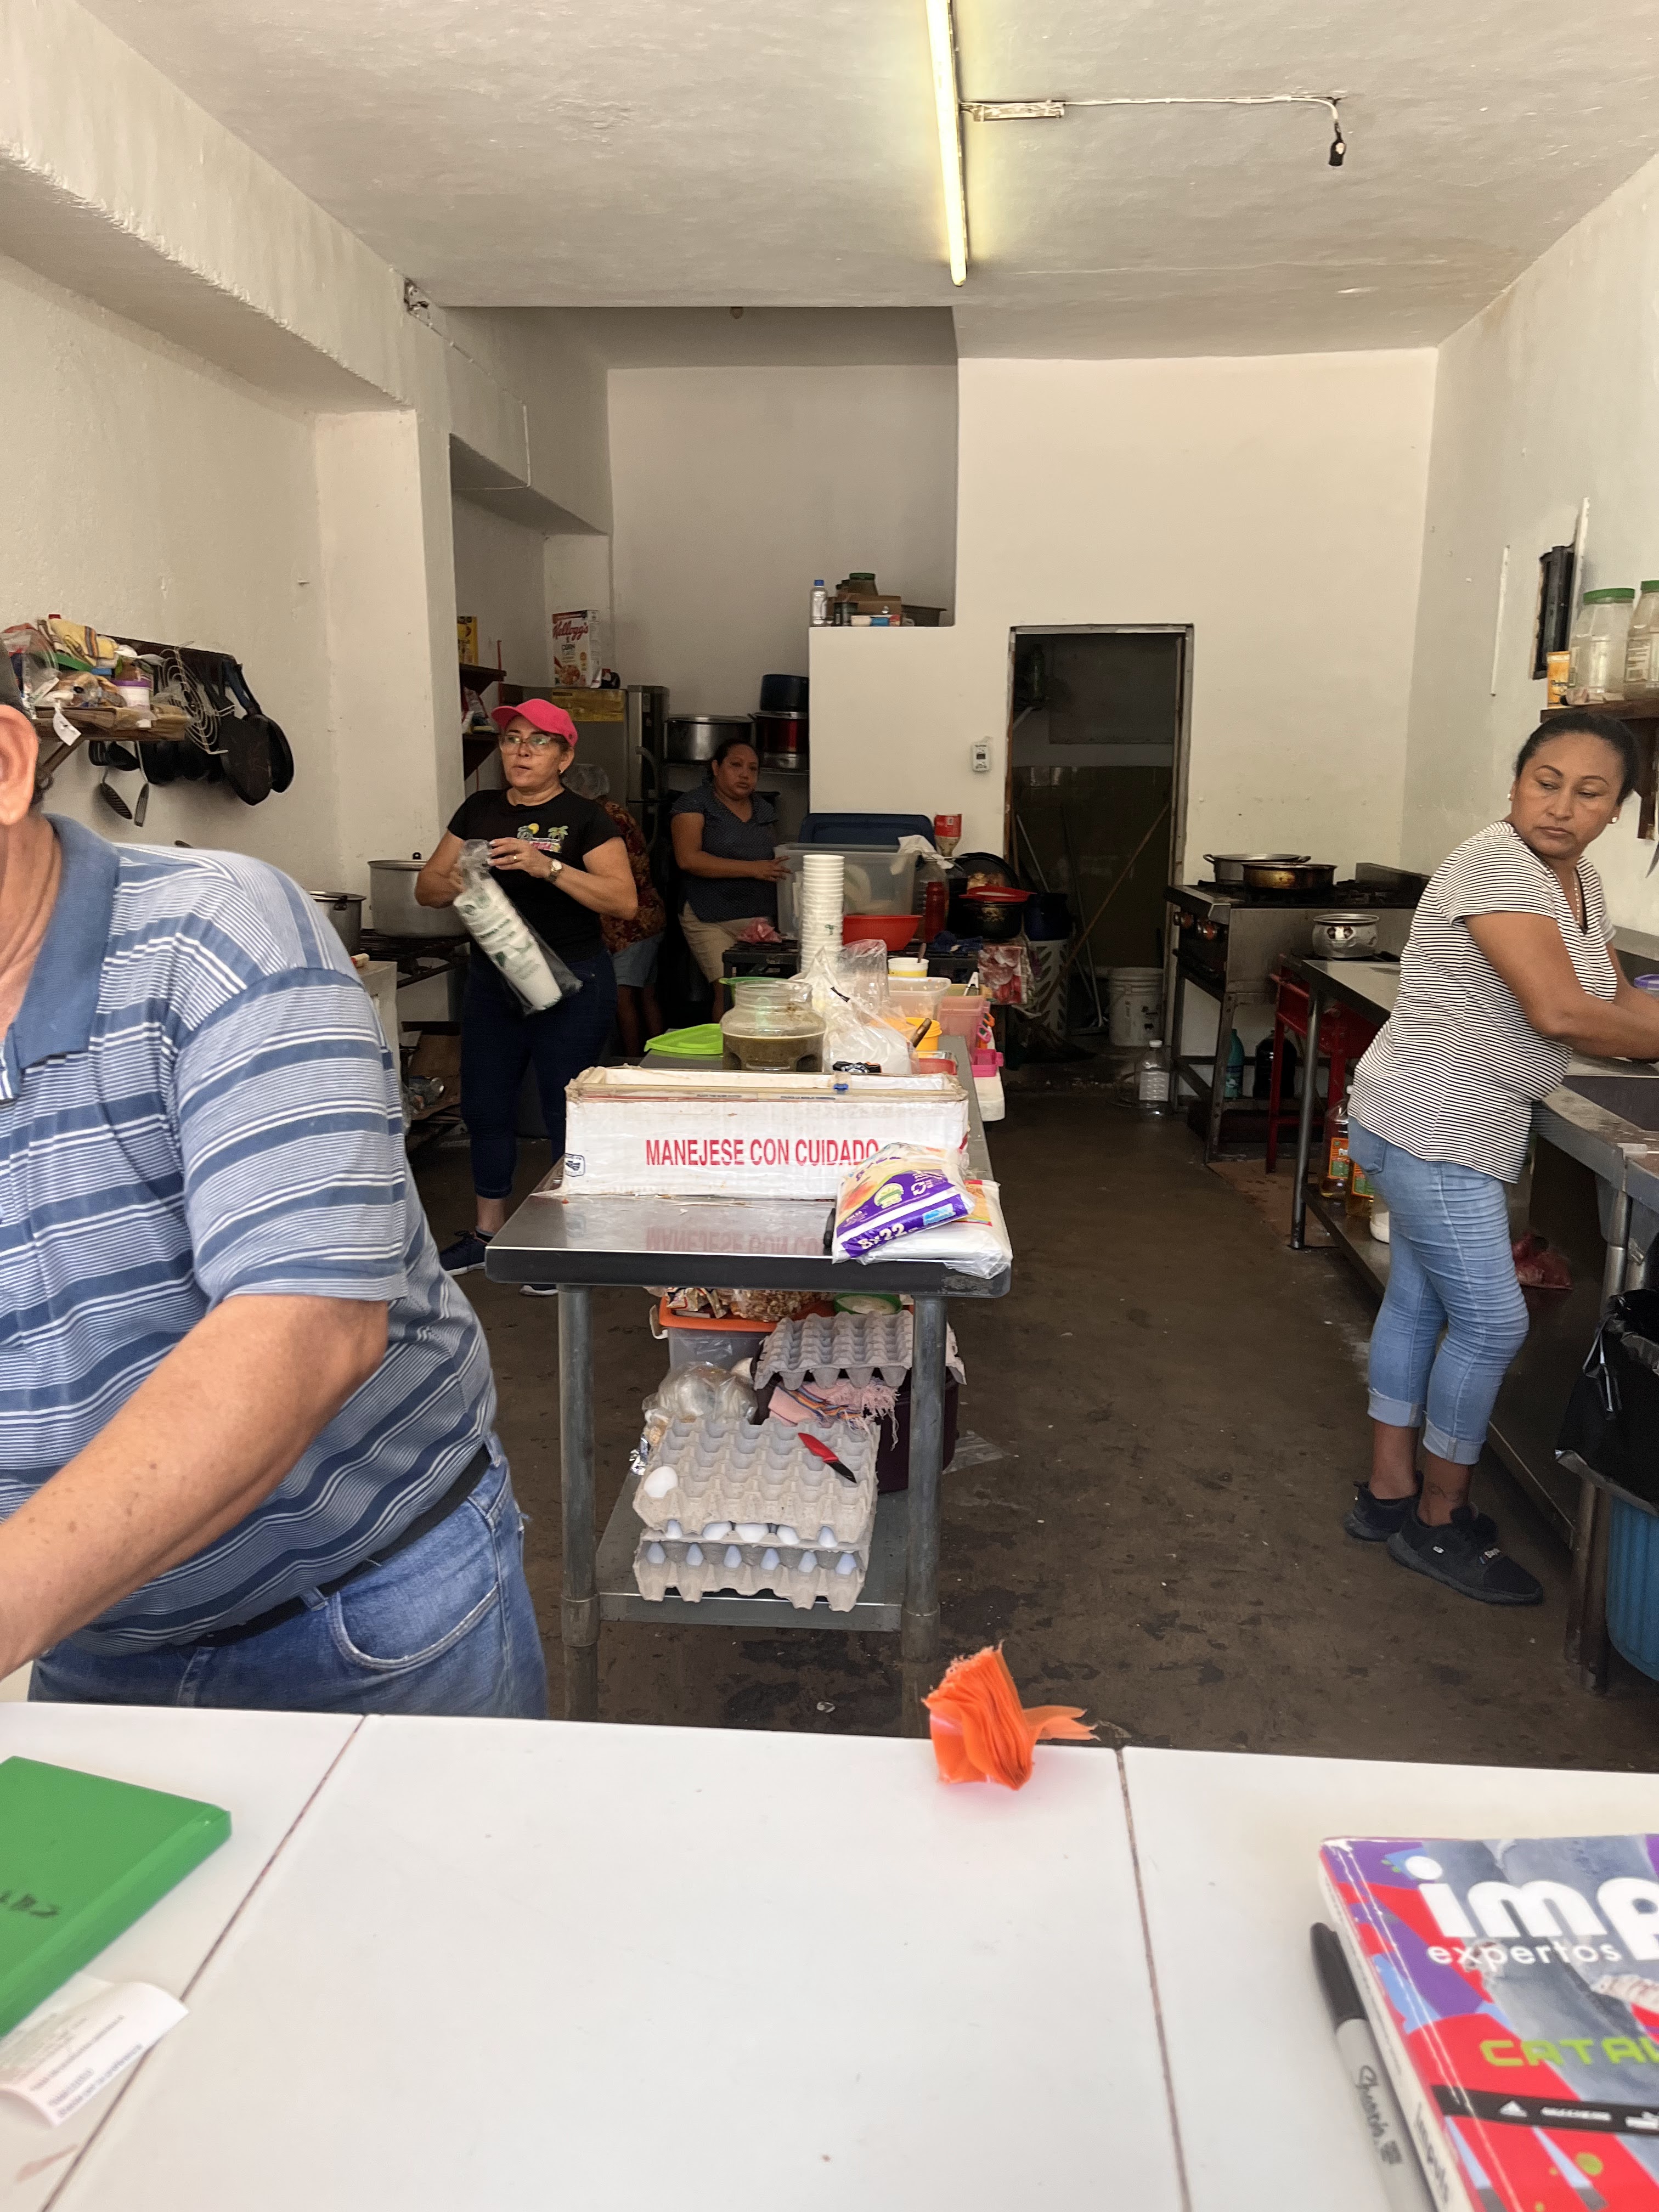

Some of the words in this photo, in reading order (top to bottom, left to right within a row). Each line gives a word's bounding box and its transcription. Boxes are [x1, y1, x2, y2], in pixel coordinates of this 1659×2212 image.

[646, 1138, 744, 1166] MANEJESE
[751, 1138, 789, 1166] CON
[795, 1138, 878, 1166] CUIDADO
[1427, 1940, 1622, 1973] expertos
